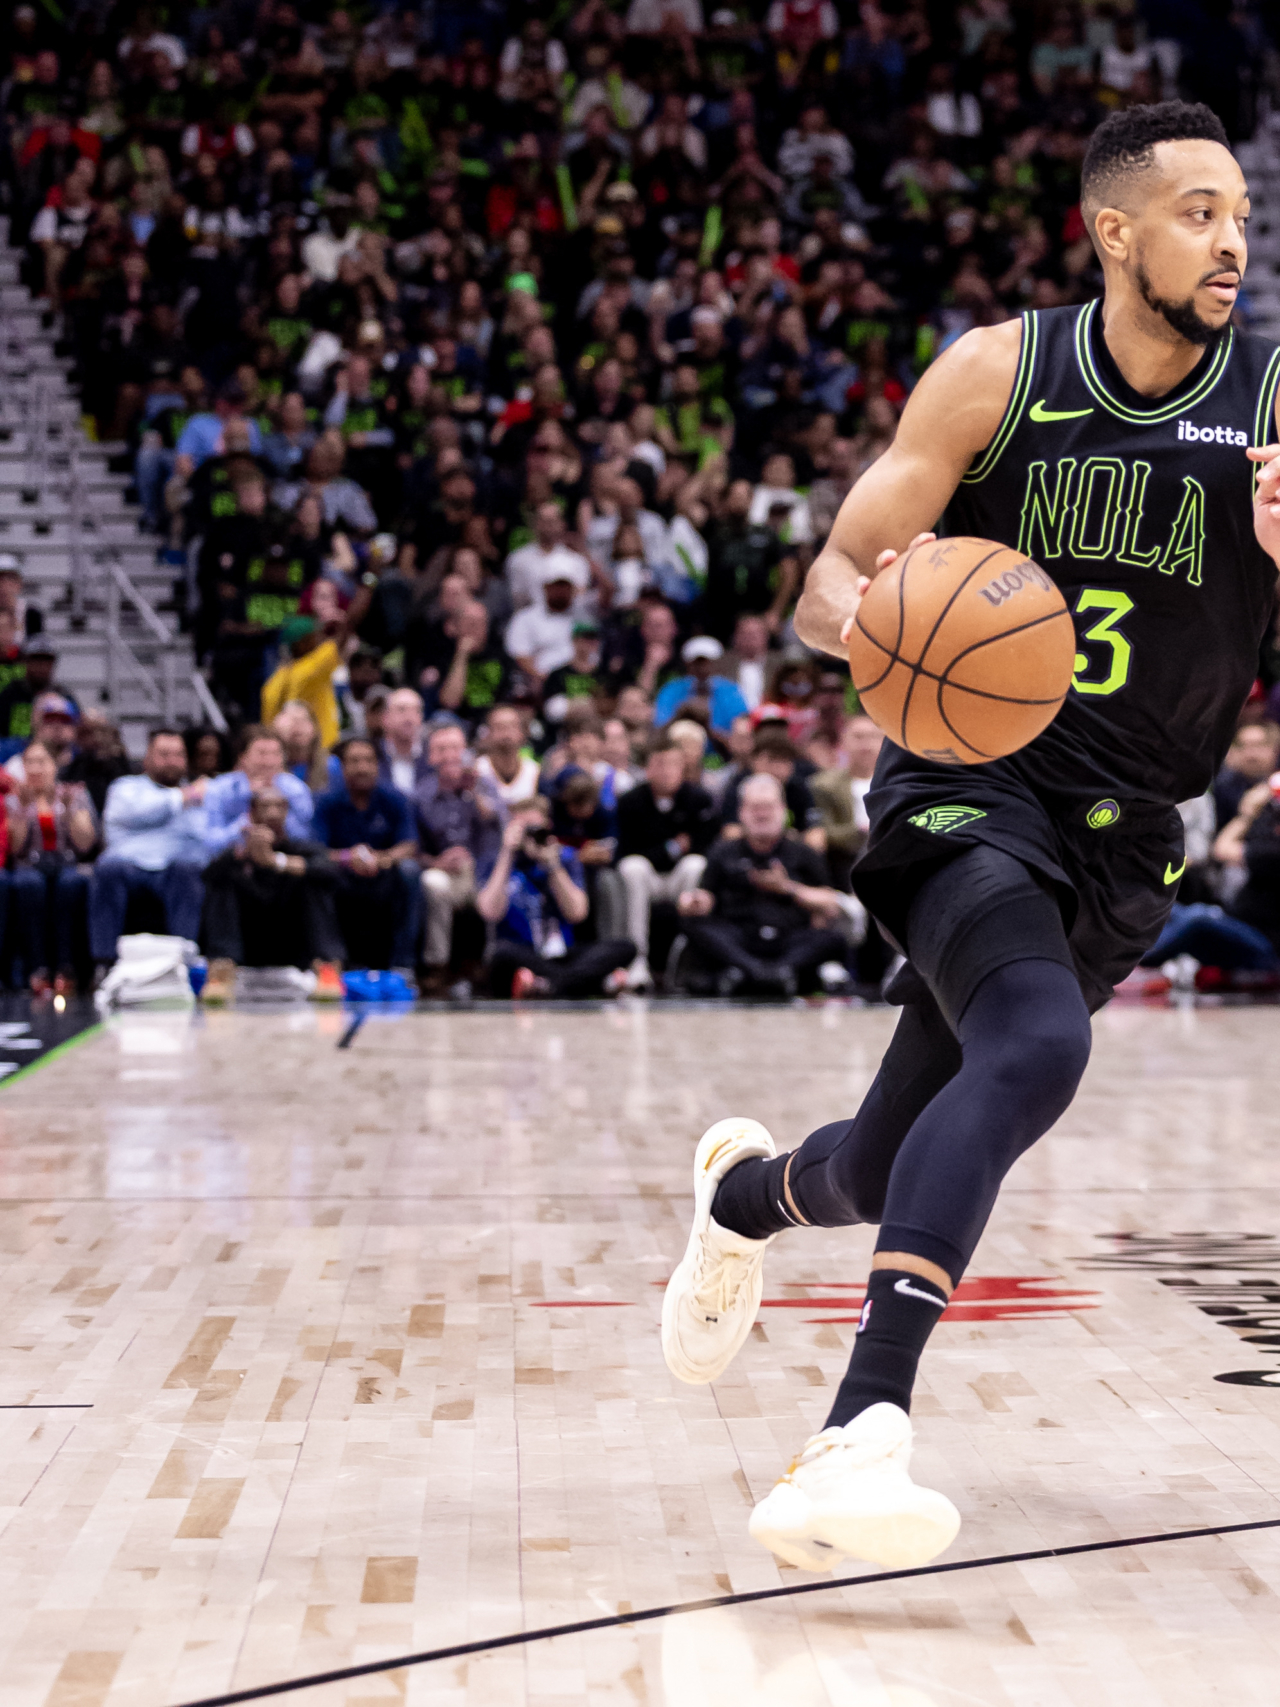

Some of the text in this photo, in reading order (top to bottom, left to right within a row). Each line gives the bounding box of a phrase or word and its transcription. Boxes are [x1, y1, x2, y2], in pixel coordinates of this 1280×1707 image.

[1178, 420, 1248, 447] ibotta
[1017, 457, 1206, 586] NOLA
[1072, 589, 1136, 696] 3
